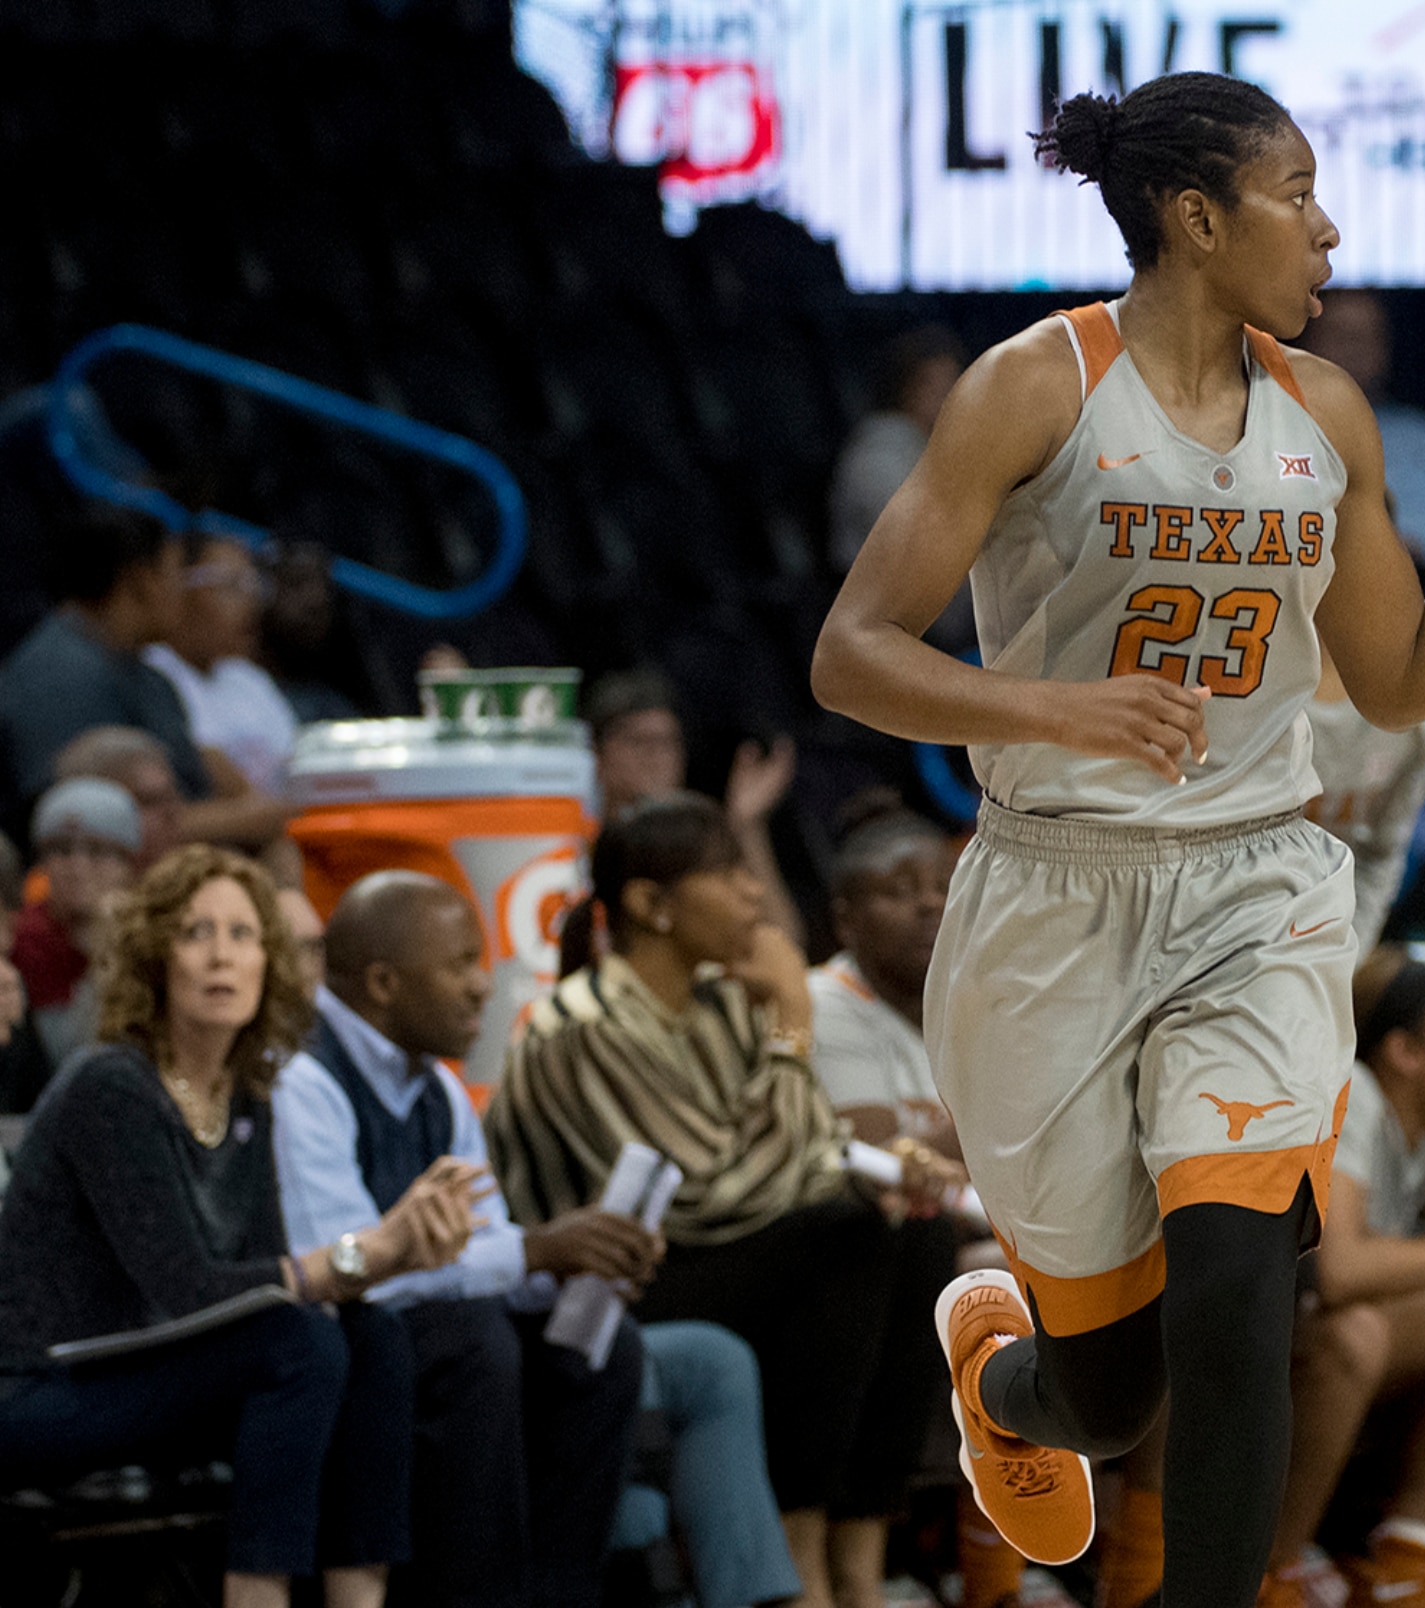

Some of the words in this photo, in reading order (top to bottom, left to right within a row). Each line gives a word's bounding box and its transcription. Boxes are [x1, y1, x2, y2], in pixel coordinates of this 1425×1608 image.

[1278, 454, 1315, 479] XII
[1100, 501, 1324, 566] TEXAS
[1107, 584, 1282, 698] 23
